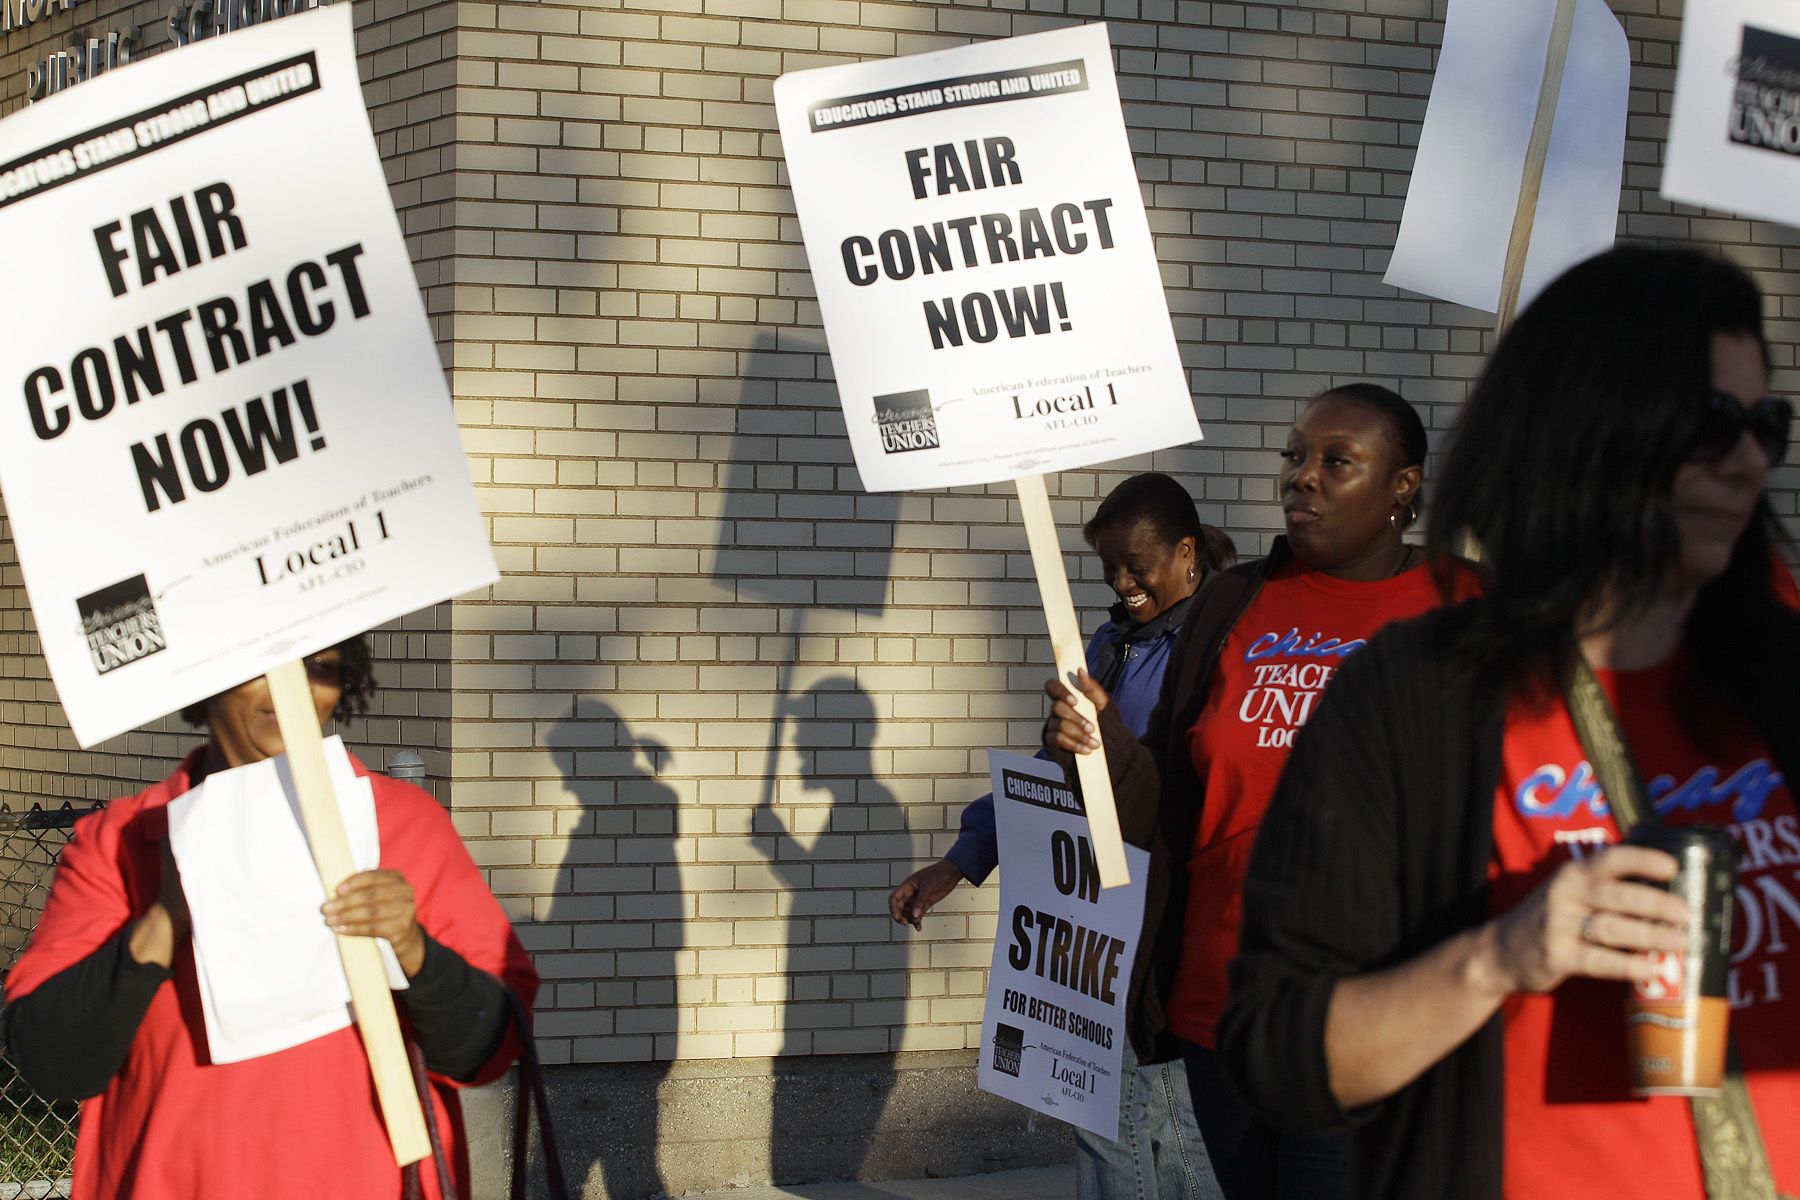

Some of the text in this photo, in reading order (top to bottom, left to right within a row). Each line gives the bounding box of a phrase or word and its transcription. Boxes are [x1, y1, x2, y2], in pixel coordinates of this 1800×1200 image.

[167, 0, 318, 49] SCHOO
[815, 69, 1081, 126] EDUCATORS STAND STRONG AND UNITED
[0, 62, 314, 201] CATORS STAND STRONG AND UNITED
[1732, 103, 1800, 155] UNIO
[905, 136, 1023, 200] FAIR
[93, 180, 248, 299] FAIR
[841, 198, 1115, 287] CONTRACT
[922, 281, 1072, 350] NOW!
[23, 242, 372, 441] CONTRACT
[970, 363, 1152, 398] American Federation of Teachers
[1011, 382, 1120, 419] Local 1
[129, 379, 328, 514] NOW!
[880, 417, 936, 437] TEACHERS
[882, 430, 939, 452] UNION
[1044, 414, 1098, 432] AFL-CIO
[256, 508, 392, 586] Local 1
[92, 627, 166, 672] UNION
[1244, 627, 1368, 663] Chica
[1253, 664, 1338, 690] TEACH
[1239, 687, 1318, 726] UNI
[1257, 727, 1299, 749] LOC
[1007, 777, 1051, 804] CHICAGO
[1051, 830, 1101, 904] ON
[1009, 905, 1126, 1006] STRIKE
[1003, 988, 1113, 1050] FOR BETTER SCHOOLS
[994, 1055, 1020, 1074] UNION
[1051, 1058, 1096, 1095] Local 1
